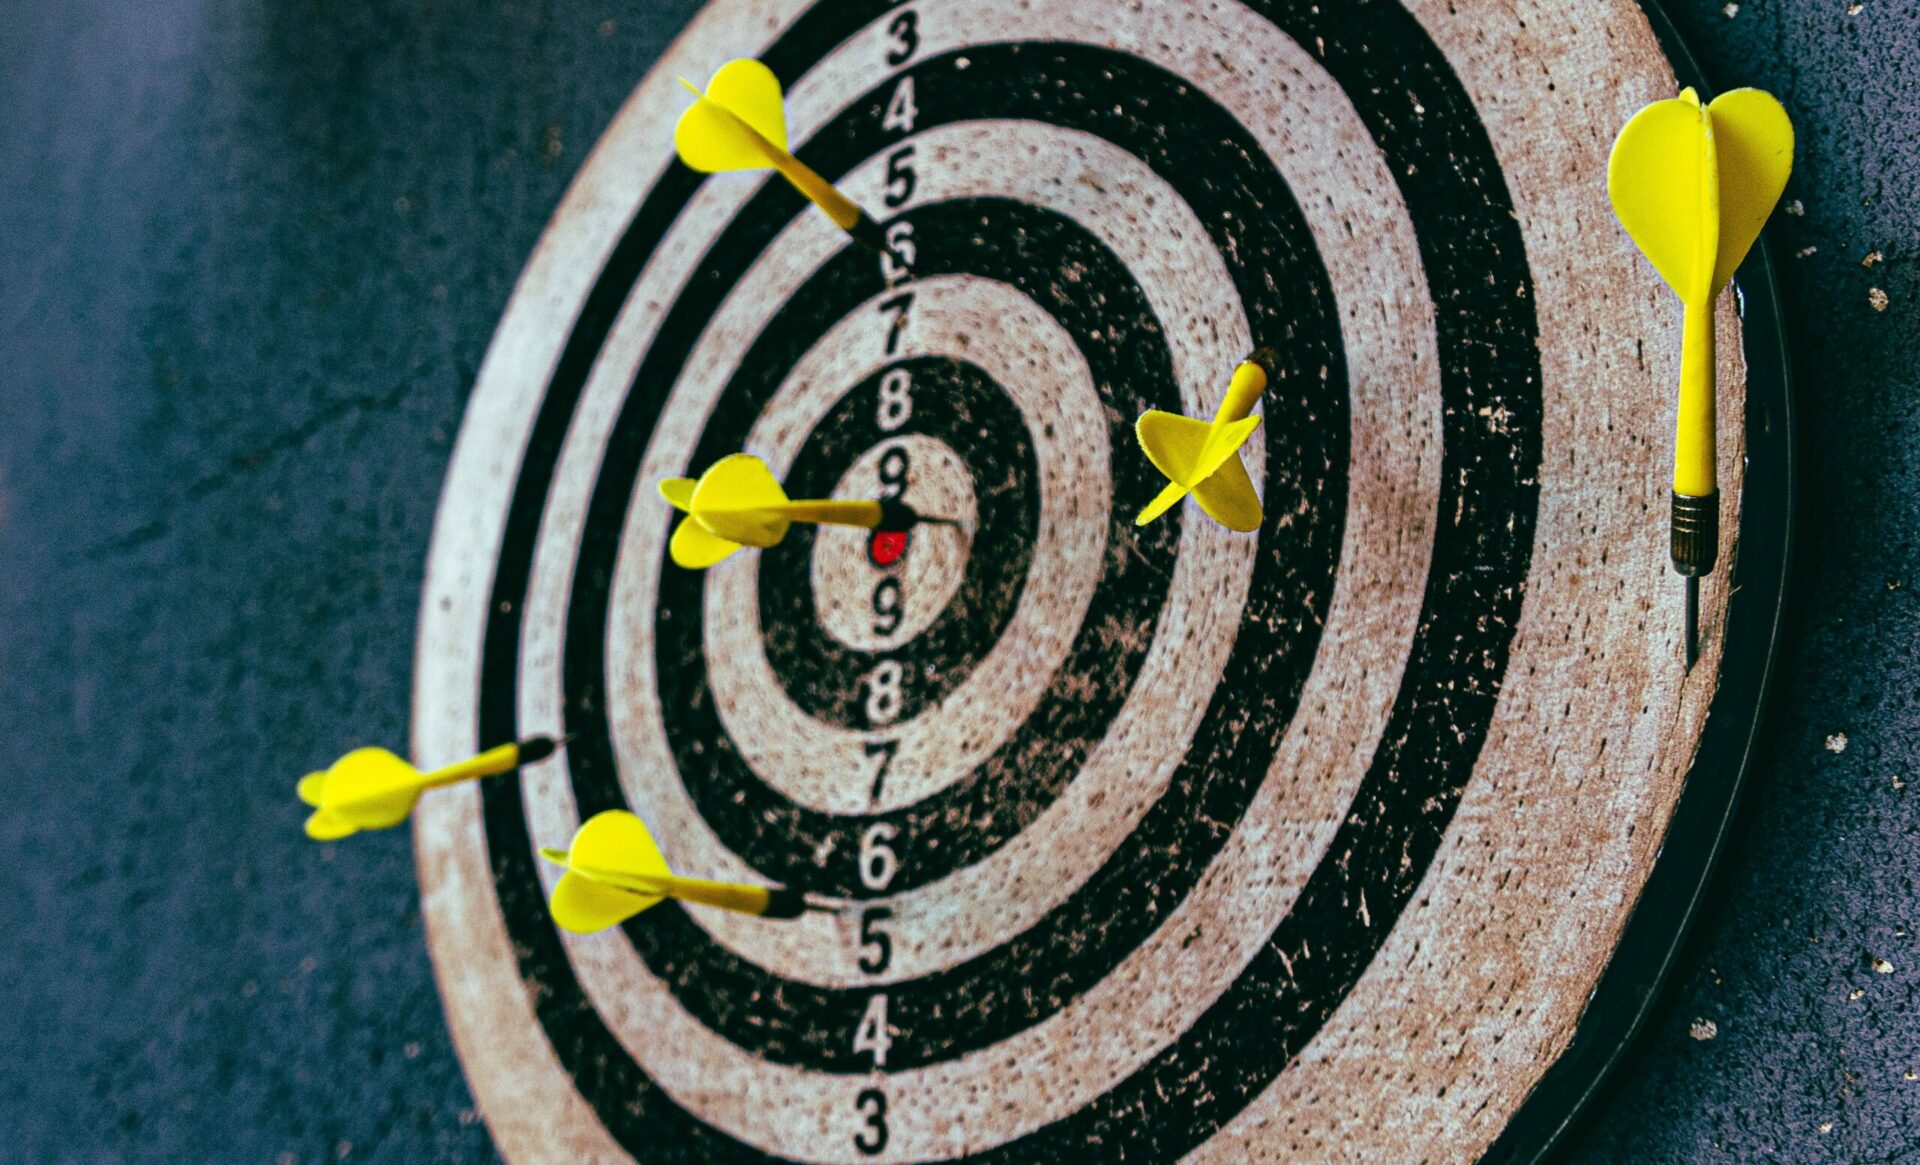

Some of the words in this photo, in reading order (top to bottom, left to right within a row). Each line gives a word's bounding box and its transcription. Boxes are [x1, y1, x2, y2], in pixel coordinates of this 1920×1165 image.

[886, 10, 919, 66] 3
[882, 75, 918, 132] 4
[885, 144, 917, 208] 5
[880, 221, 916, 284] 6
[879, 290, 916, 355] 7
[877, 368, 912, 432] 8
[879, 446, 909, 500] 9
[873, 576, 903, 637] 9
[866, 660, 902, 724] 8
[864, 740, 899, 801] 7
[860, 822, 899, 890] 6
[858, 907, 893, 974] 5
[853, 994, 892, 1066] 4
[854, 1088, 889, 1155] 3
